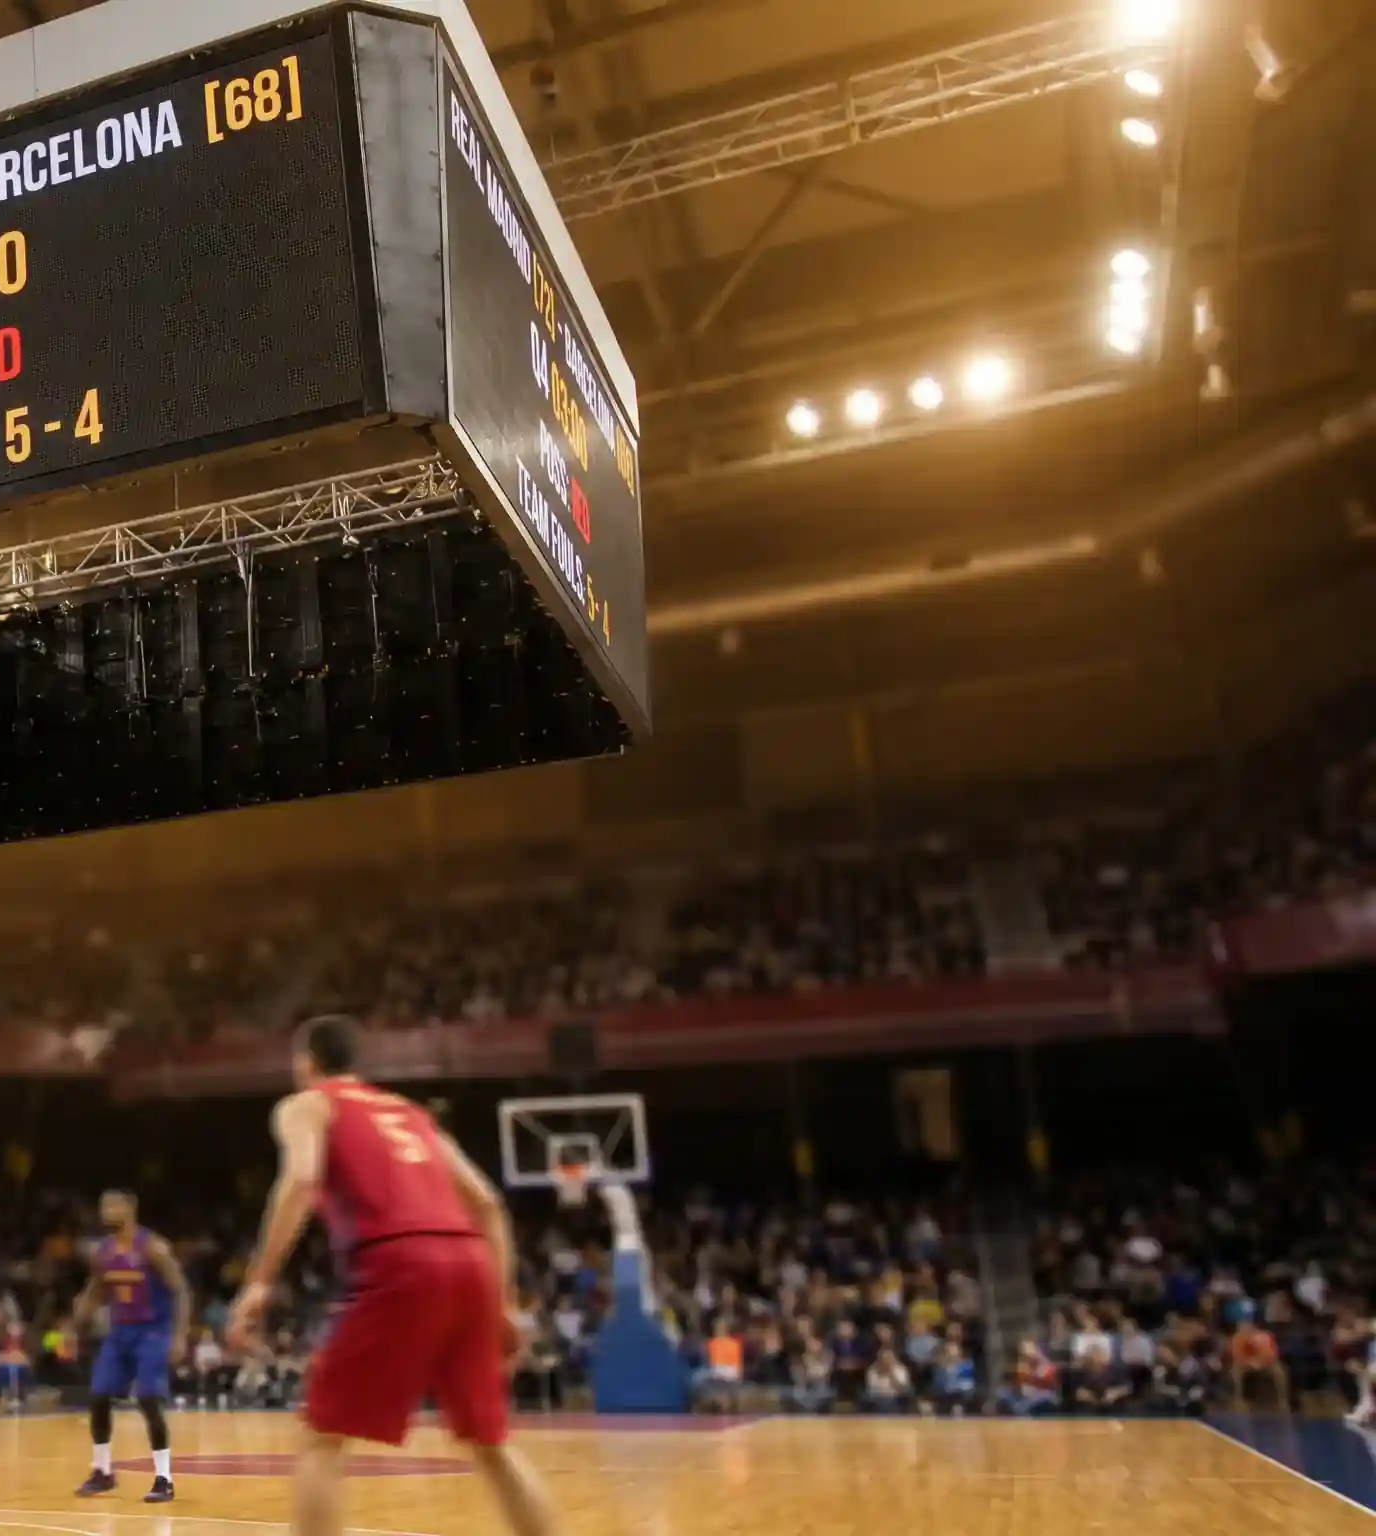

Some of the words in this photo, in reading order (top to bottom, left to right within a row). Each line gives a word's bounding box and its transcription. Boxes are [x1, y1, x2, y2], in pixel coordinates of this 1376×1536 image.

[204, 55, 303, 144] [68]
[450, 89, 485, 196] REAL
[486, 159, 532, 285] MADRID
[4, 405, 31, 463] 5
[44, 420, 62, 433] -
[74, 387, 104, 445] 4
[515, 454, 550, 549] TEAM
[586, 573, 596, 623] 5
[603, 599, 611, 647] 4
